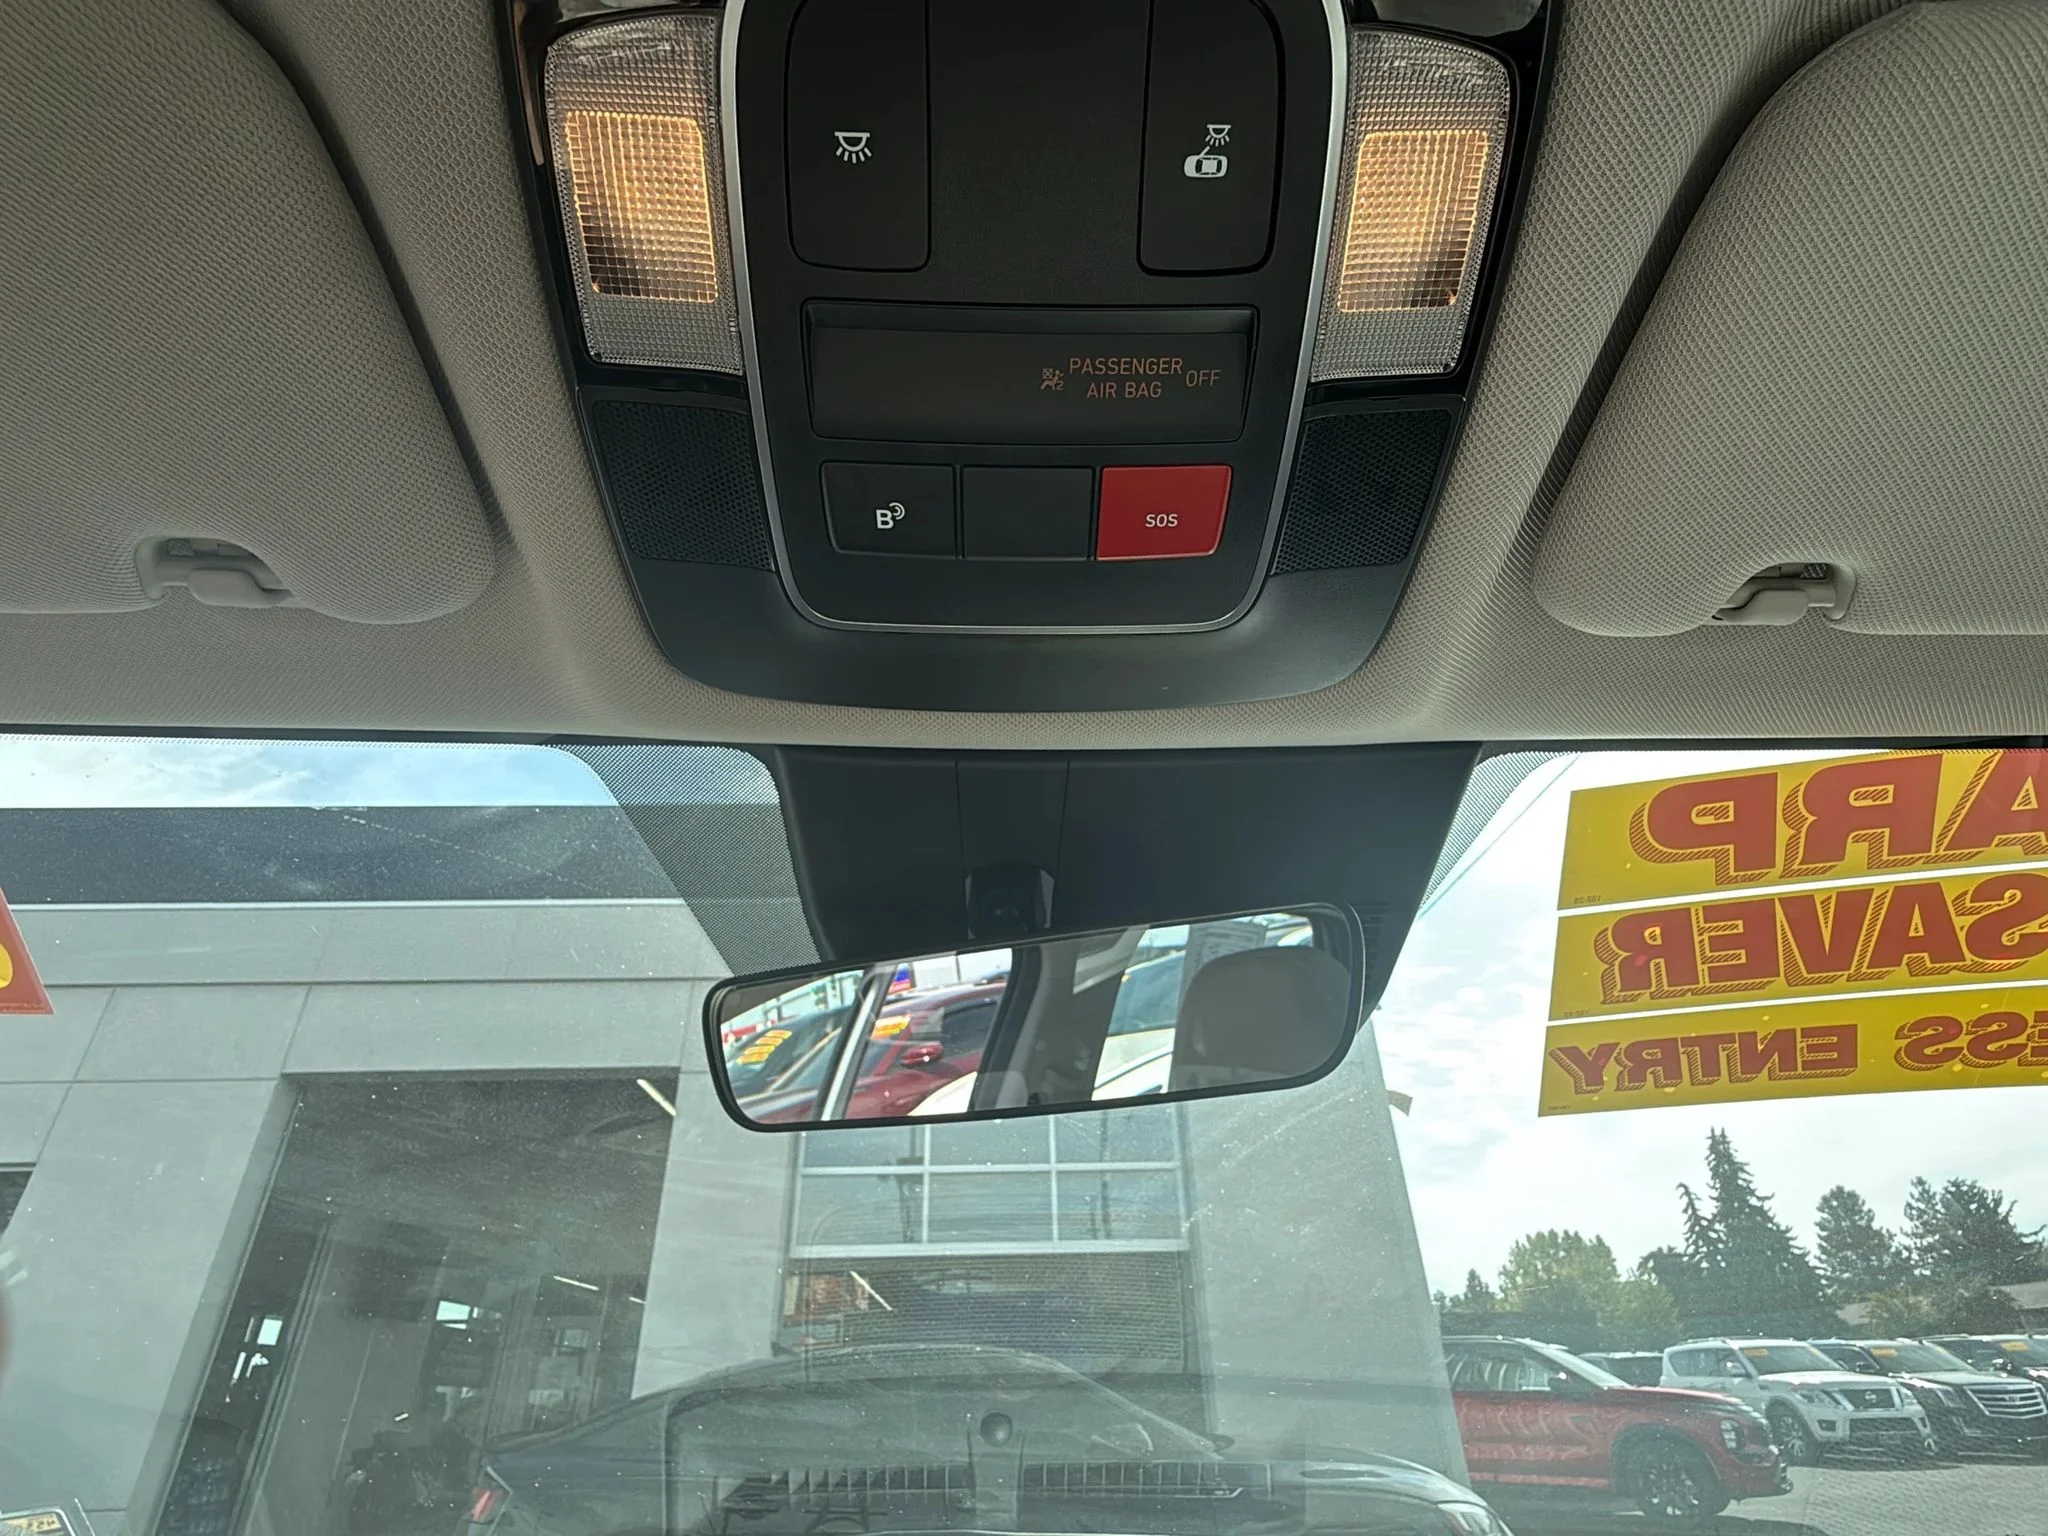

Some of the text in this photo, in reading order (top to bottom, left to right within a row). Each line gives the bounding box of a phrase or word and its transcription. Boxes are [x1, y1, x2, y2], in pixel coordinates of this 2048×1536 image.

[1068, 356, 1184, 376] PASSENGER
[1184, 368, 1222, 388] OFF
[1085, 380, 1163, 400] AIR BAG
[1144, 512, 1179, 528] SOS
